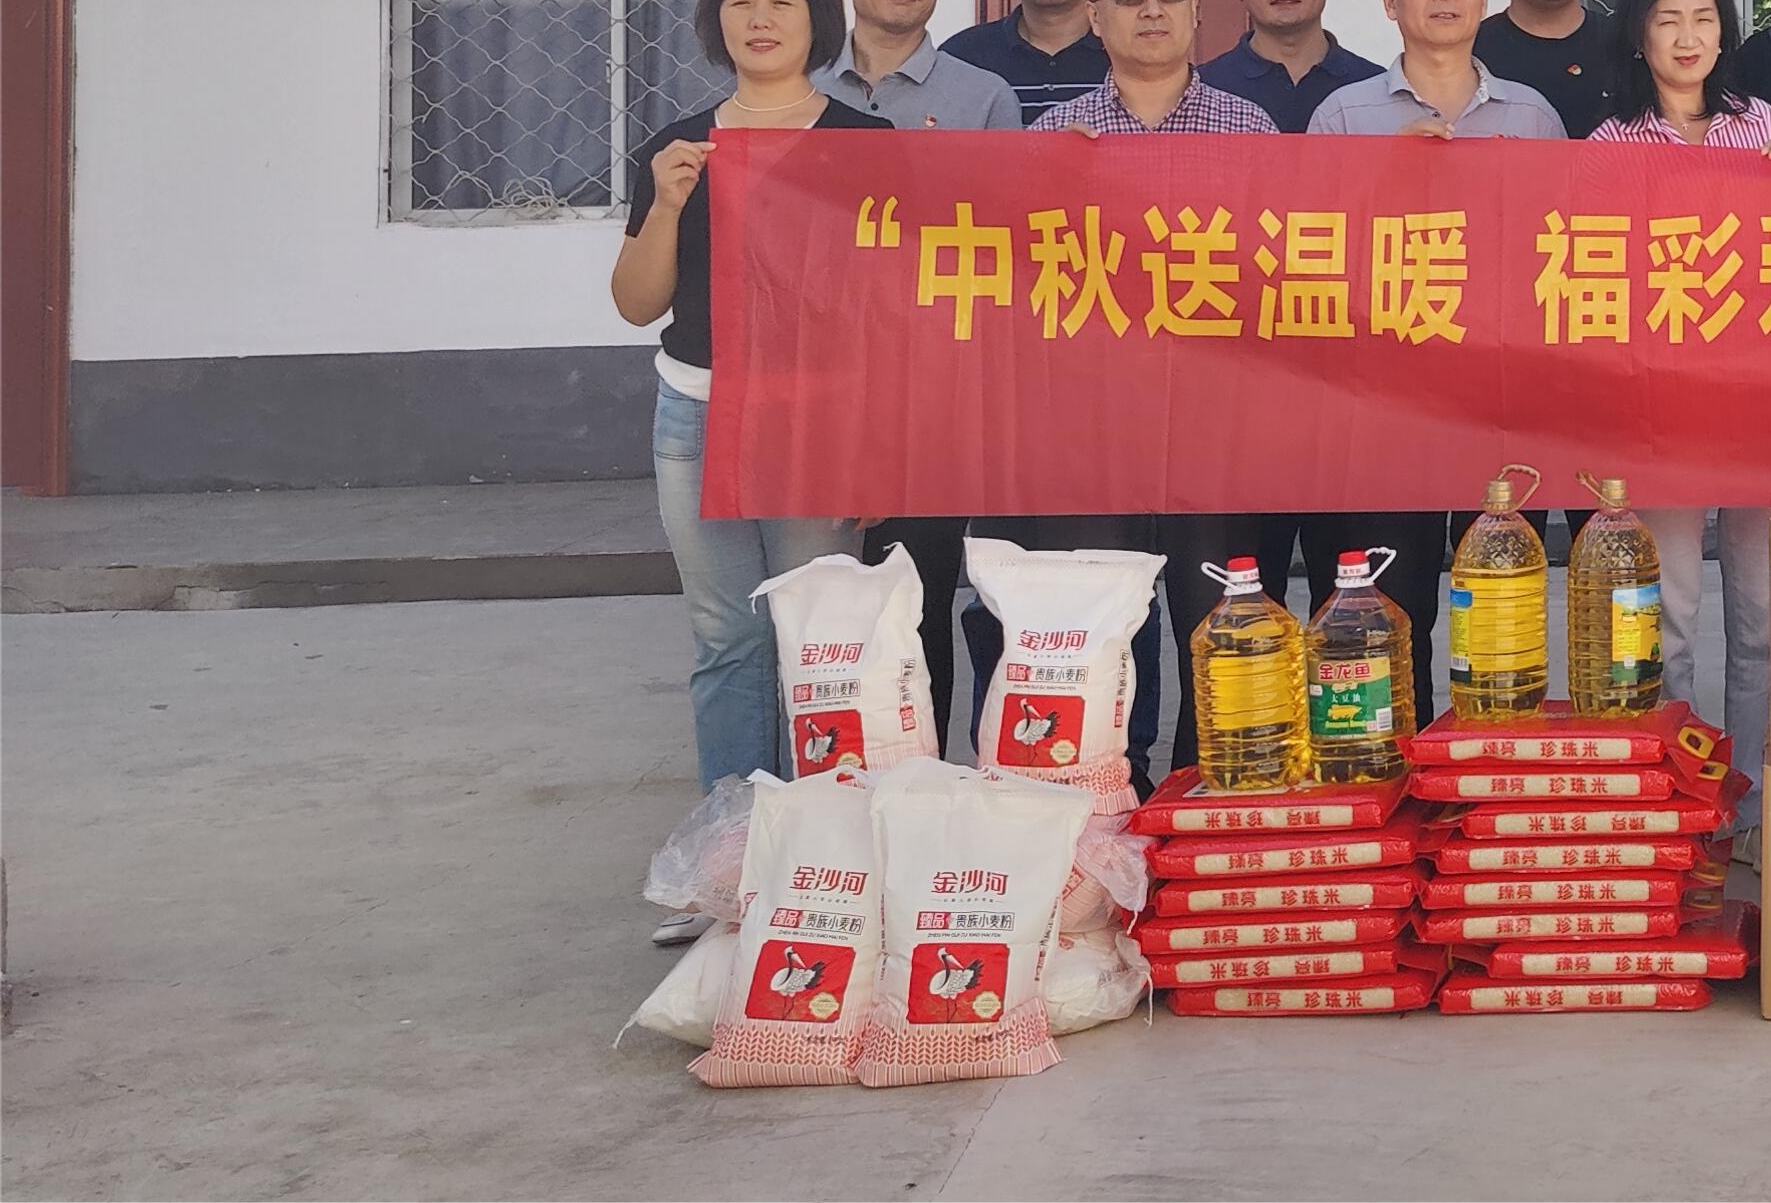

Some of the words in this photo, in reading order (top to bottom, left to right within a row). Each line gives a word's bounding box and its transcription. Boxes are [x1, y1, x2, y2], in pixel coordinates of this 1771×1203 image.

[855, 196, 1469, 345] “中秋送温暖
[1017, 629, 1089, 651] 金沙河
[799, 642, 865, 666] 金沙河
[1319, 662, 1372, 680] 金龙鱼
[789, 865, 870, 896] 金沙河
[931, 869, 1009, 896] 金沙河
[807, 912, 863, 935] 贵族小麦粉
[956, 913, 1013, 930] 贵族小麦粉
